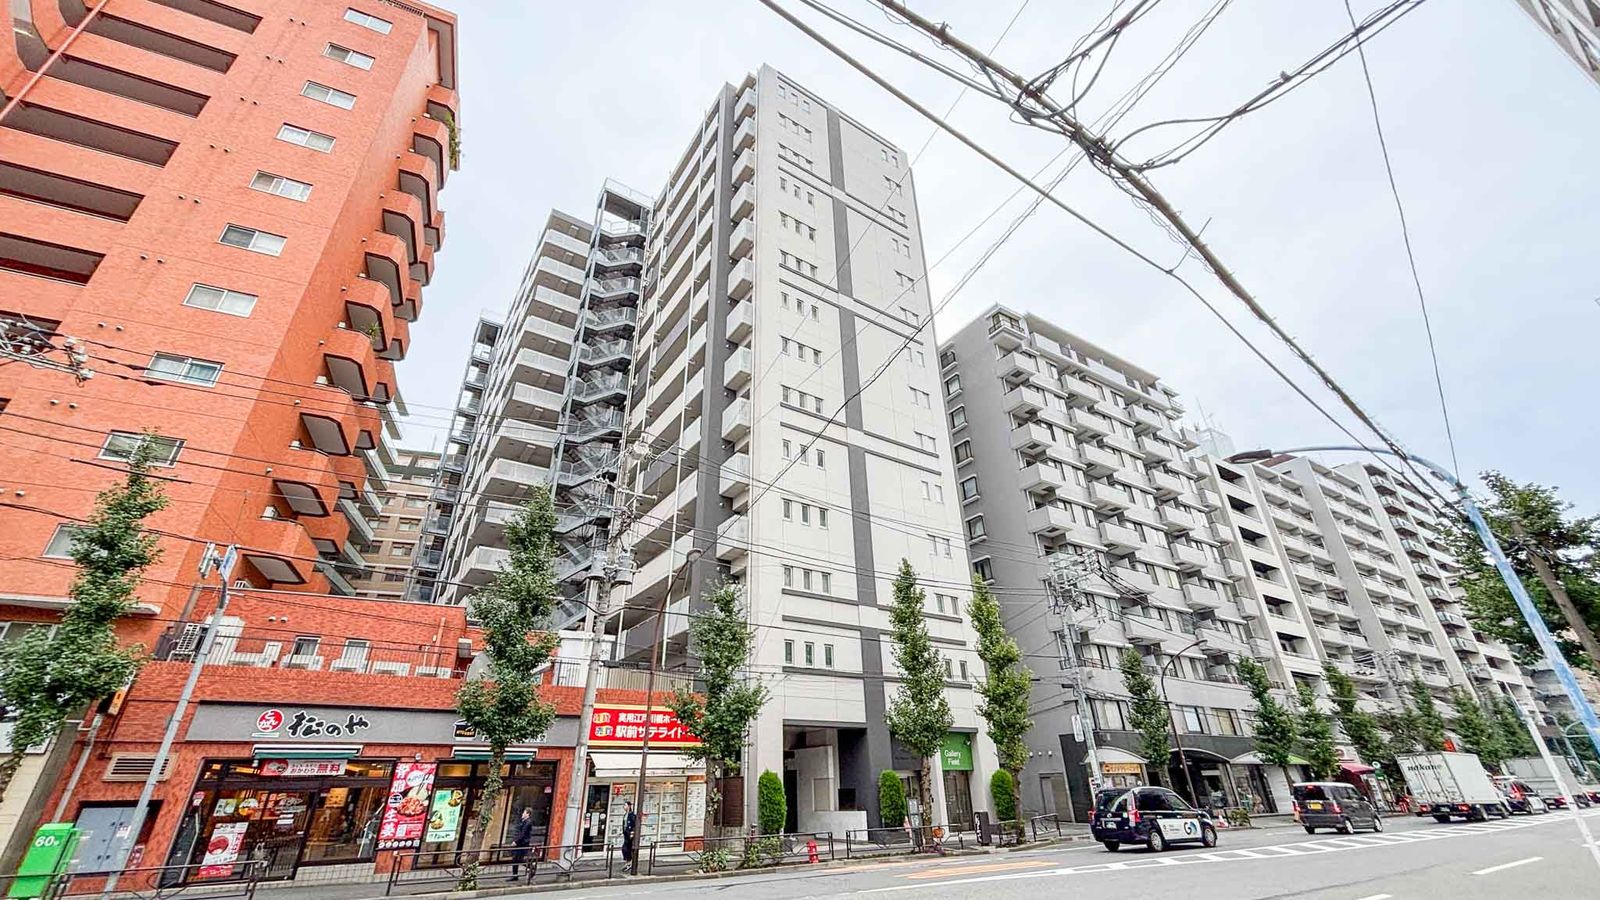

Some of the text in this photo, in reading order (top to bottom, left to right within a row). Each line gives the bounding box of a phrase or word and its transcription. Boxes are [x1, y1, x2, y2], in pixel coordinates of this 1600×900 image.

[287, 710, 370, 737] 松のや
[615, 725, 697, 739] 駅前サテライト
[944, 750, 961, 759] Gallery
